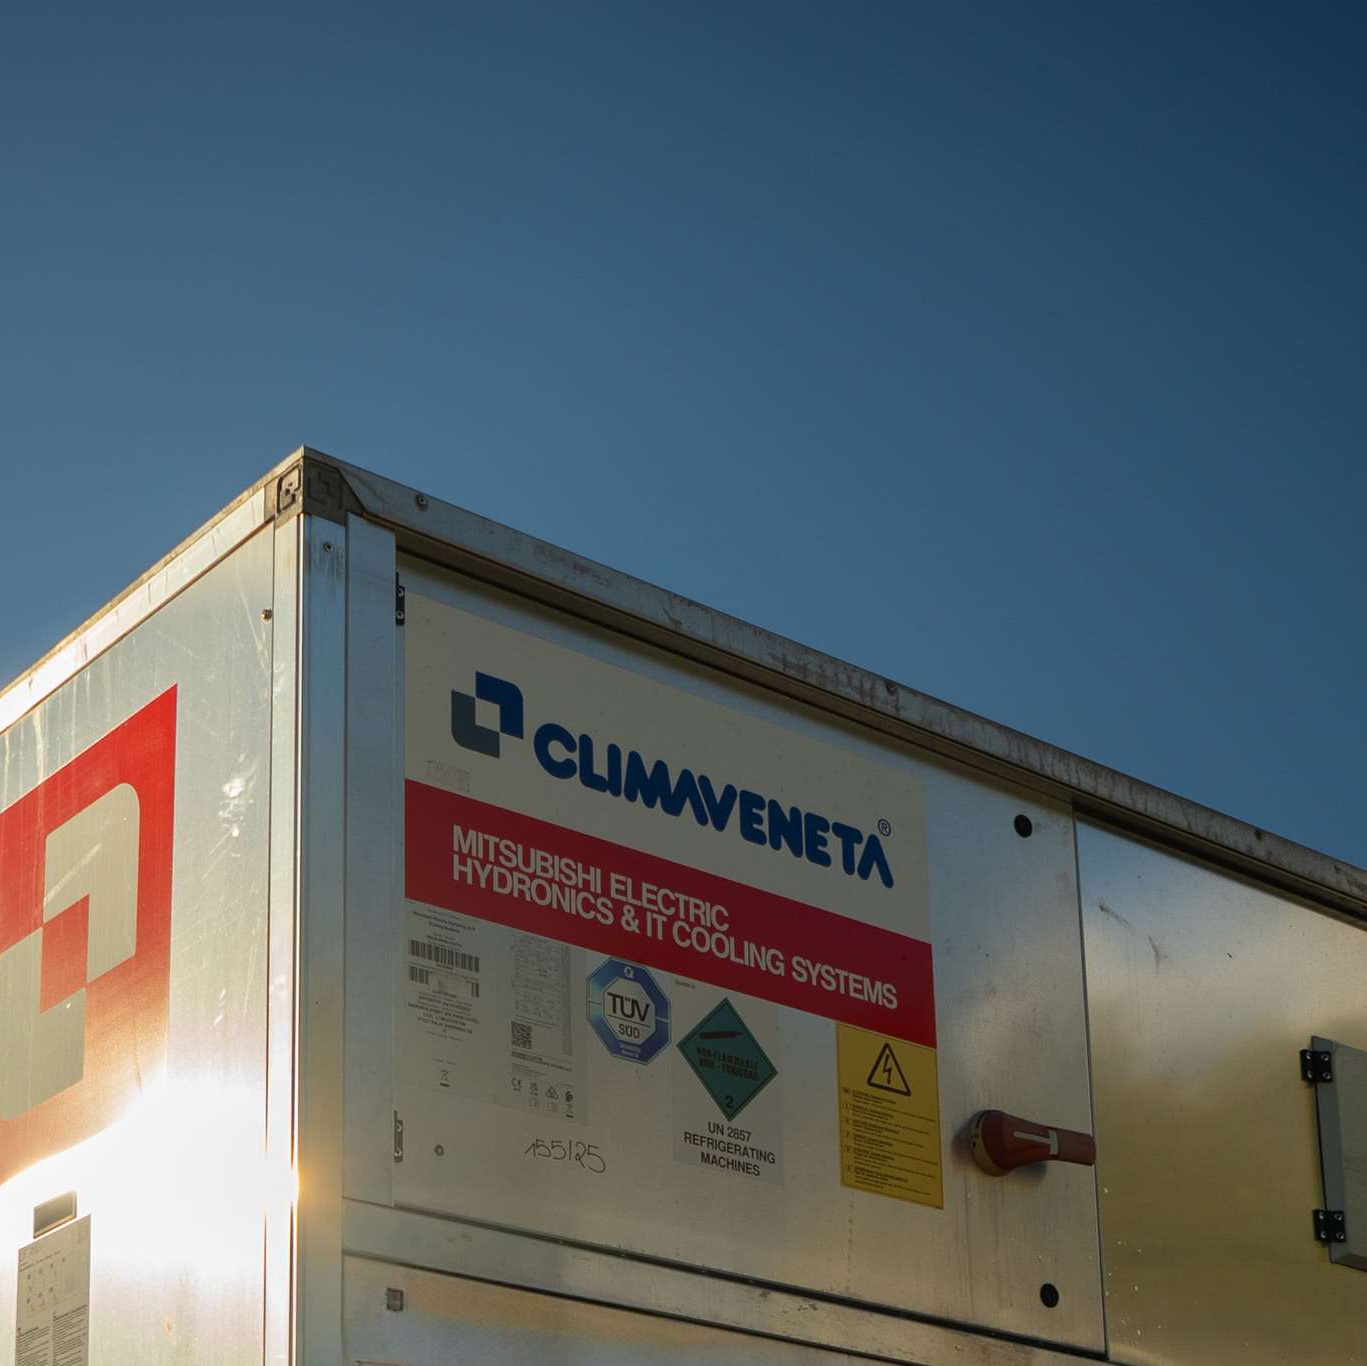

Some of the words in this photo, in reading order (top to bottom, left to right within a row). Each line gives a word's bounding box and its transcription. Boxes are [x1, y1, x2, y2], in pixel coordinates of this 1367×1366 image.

[533, 722, 894, 889] CLIMAVENETA
[452, 824, 602, 894] MITSUBISHI
[609, 872, 729, 932] ELECTRIC
[452, 854, 614, 926] HYDRONICS
[620, 904, 640, 933] &
[645, 911, 667, 940] IT
[672, 921, 785, 976] COOLING
[791, 956, 898, 1010] SYSTEMS
[607, 992, 651, 1022] TÜV
[618, 1023, 641, 1040] SÜD
[724, 1094, 735, 1109] 2
[707, 1121, 725, 1137] UN
[727, 1126, 752, 1143] 2857
[684, 1131, 776, 1165] REFRIGERATING
[700, 1152, 761, 1177] MACHINES
